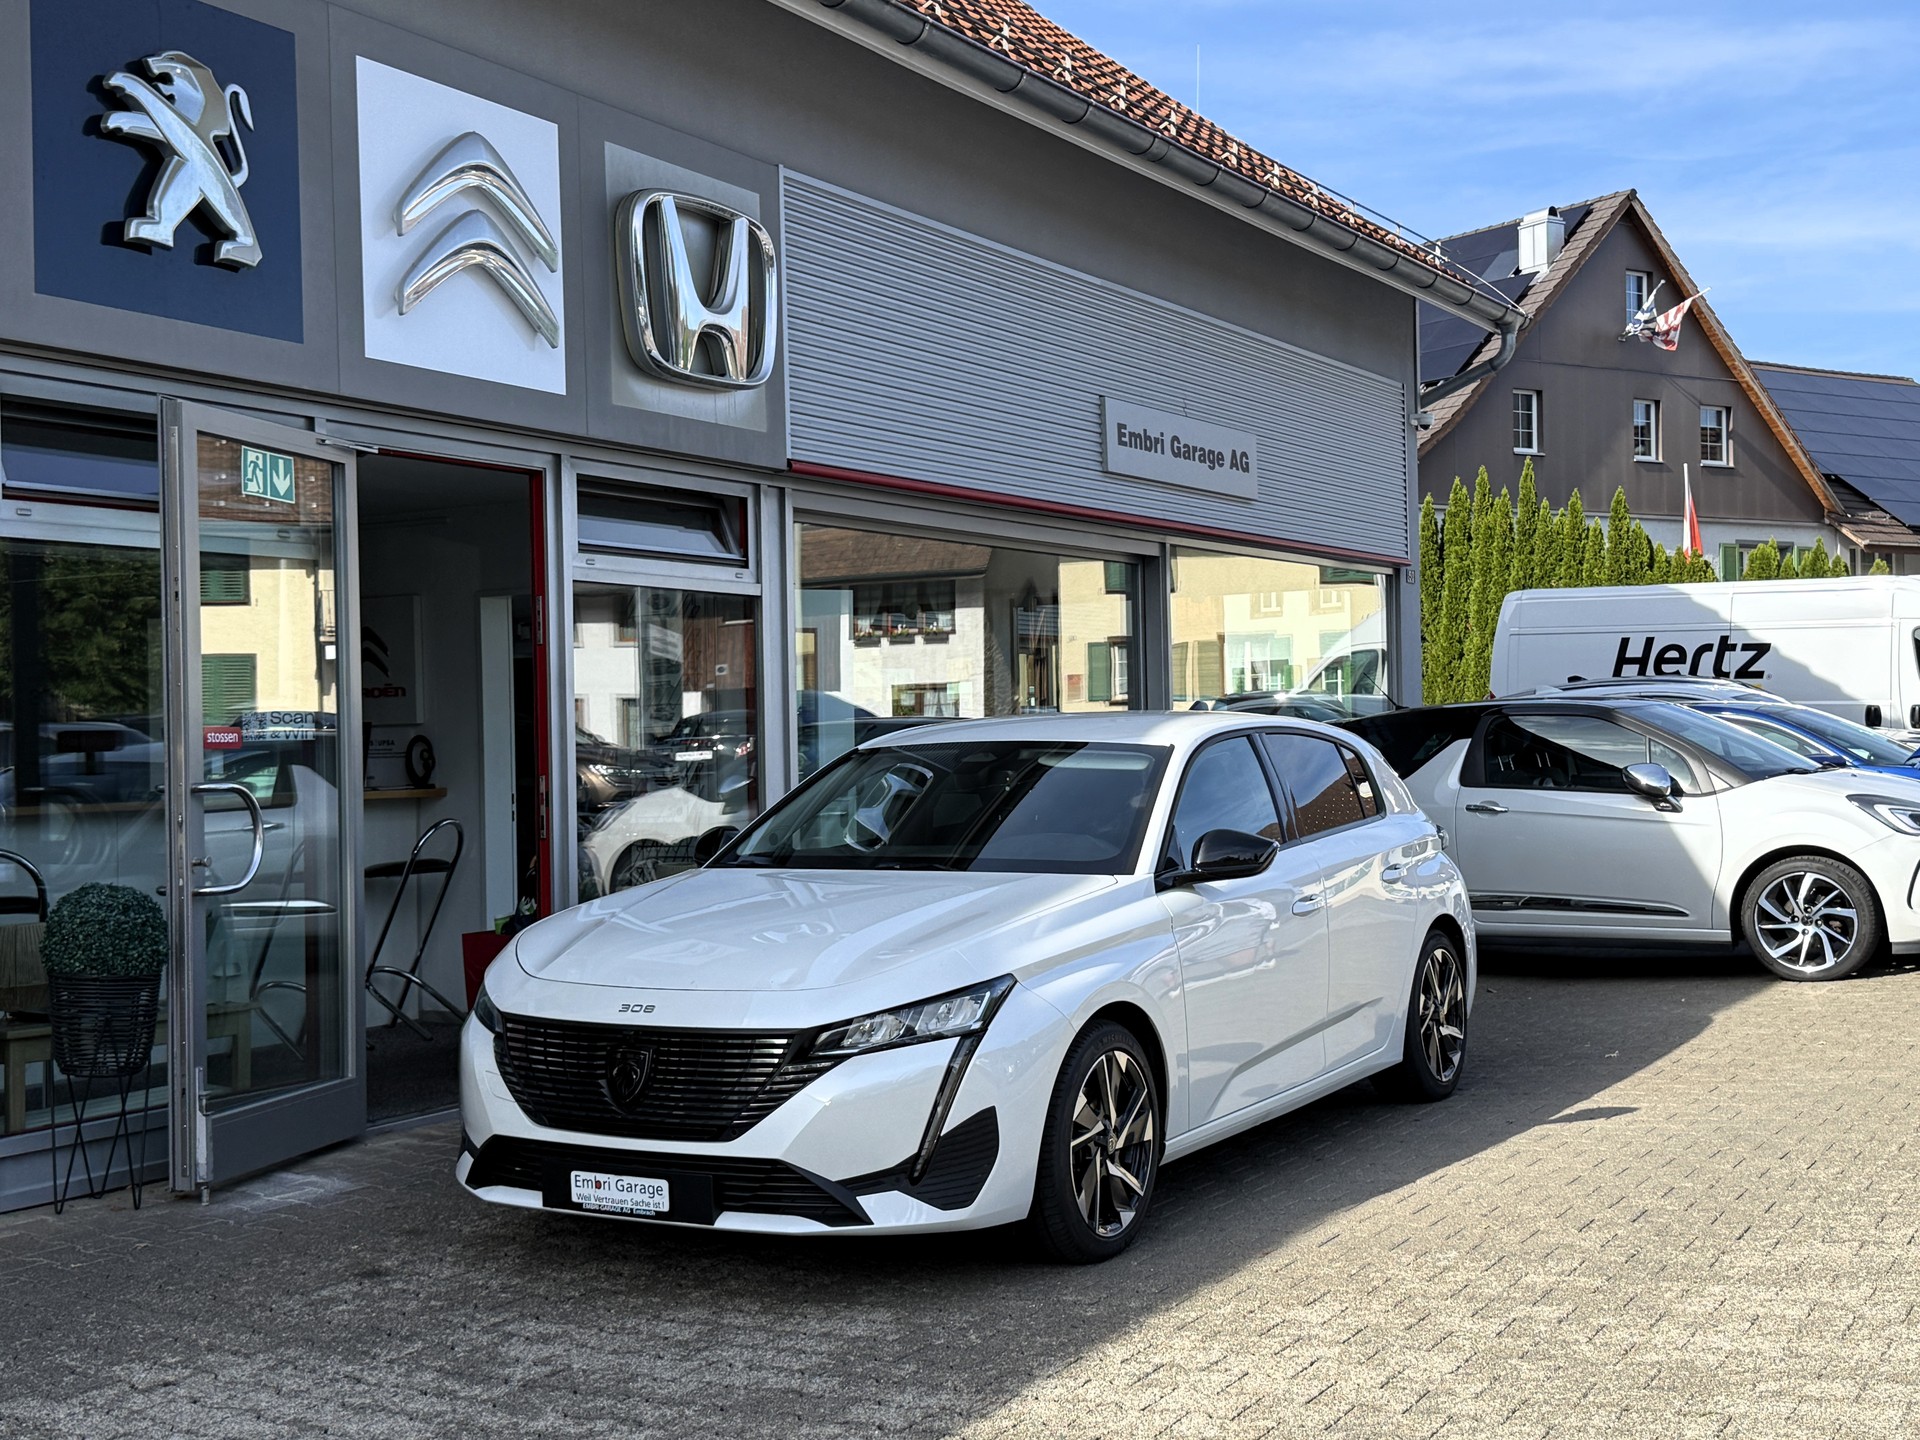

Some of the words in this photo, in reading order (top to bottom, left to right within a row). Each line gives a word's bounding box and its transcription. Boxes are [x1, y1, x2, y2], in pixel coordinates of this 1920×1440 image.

[1117, 422, 1165, 455] Embri
[1170, 435, 1225, 471] Garage
[1229, 449, 1250, 473] AG
[1612, 635, 1772, 680] Hertz
[270, 711, 315, 725] Scan
[207, 731, 239, 743] stossen
[271, 731, 280, 739] &
[618, 1003, 656, 1014] 308
[574, 1174, 611, 1191] Embri
[615, 1178, 664, 1199] Garage
[576, 1193, 591, 1202] Weil
[593, 1194, 629, 1206] Vertrauen
[630, 1197, 651, 1208] Sache
[652, 1200, 661, 1209] ist
